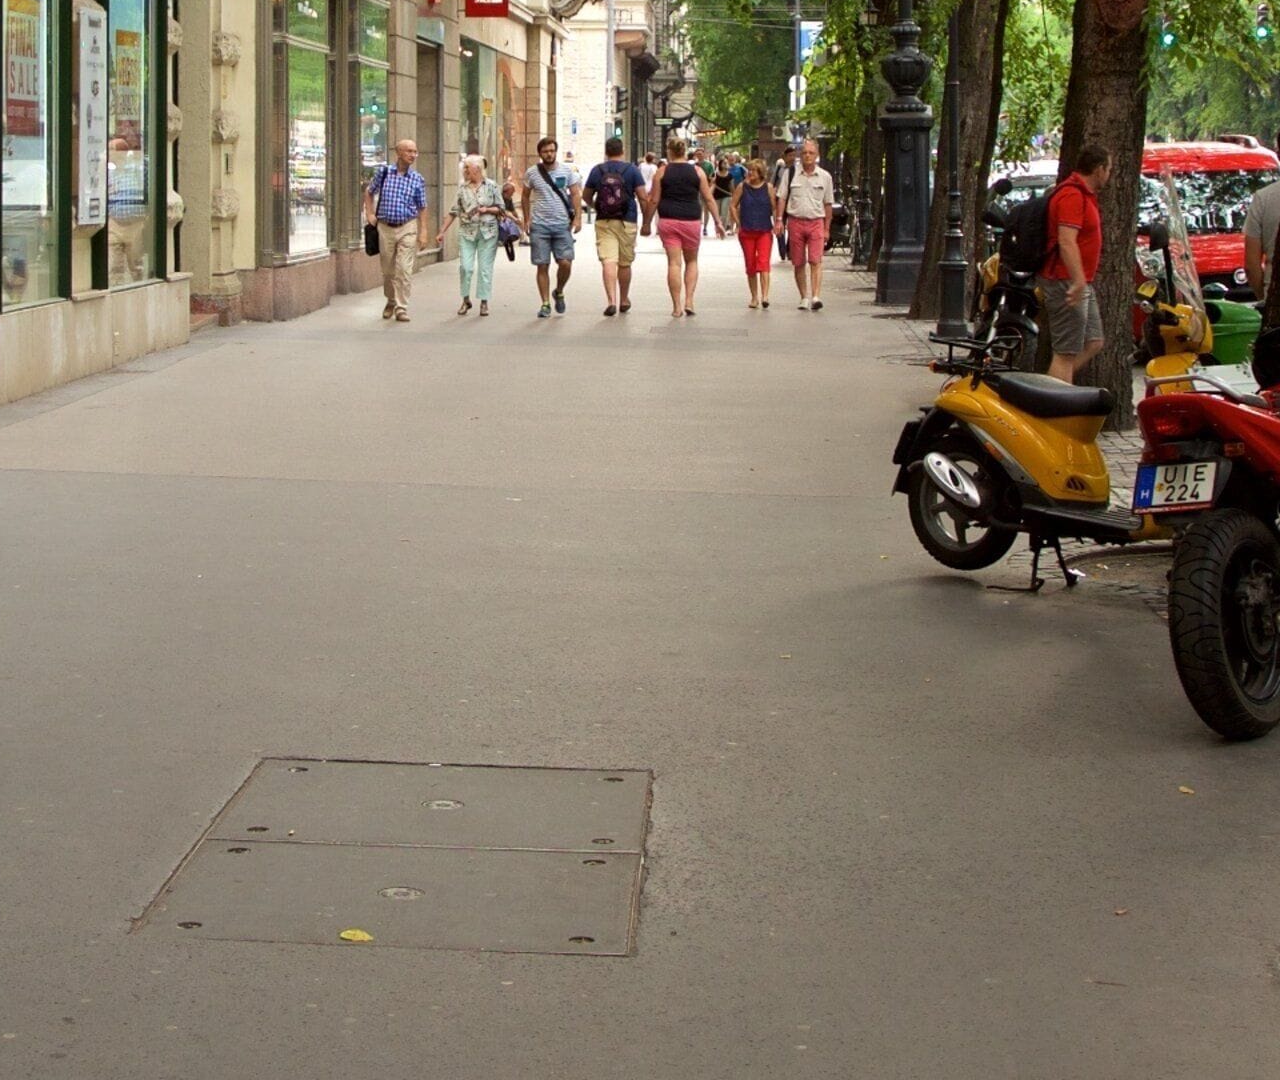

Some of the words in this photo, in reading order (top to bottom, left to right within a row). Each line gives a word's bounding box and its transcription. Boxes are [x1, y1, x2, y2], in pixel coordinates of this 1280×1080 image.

[10, 14, 39, 58] FINAL
[10, 62, 39, 96] SALE
[1164, 464, 1208, 484] UIE
[1140, 489, 1150, 500] H
[1164, 484, 1200, 502] 224
